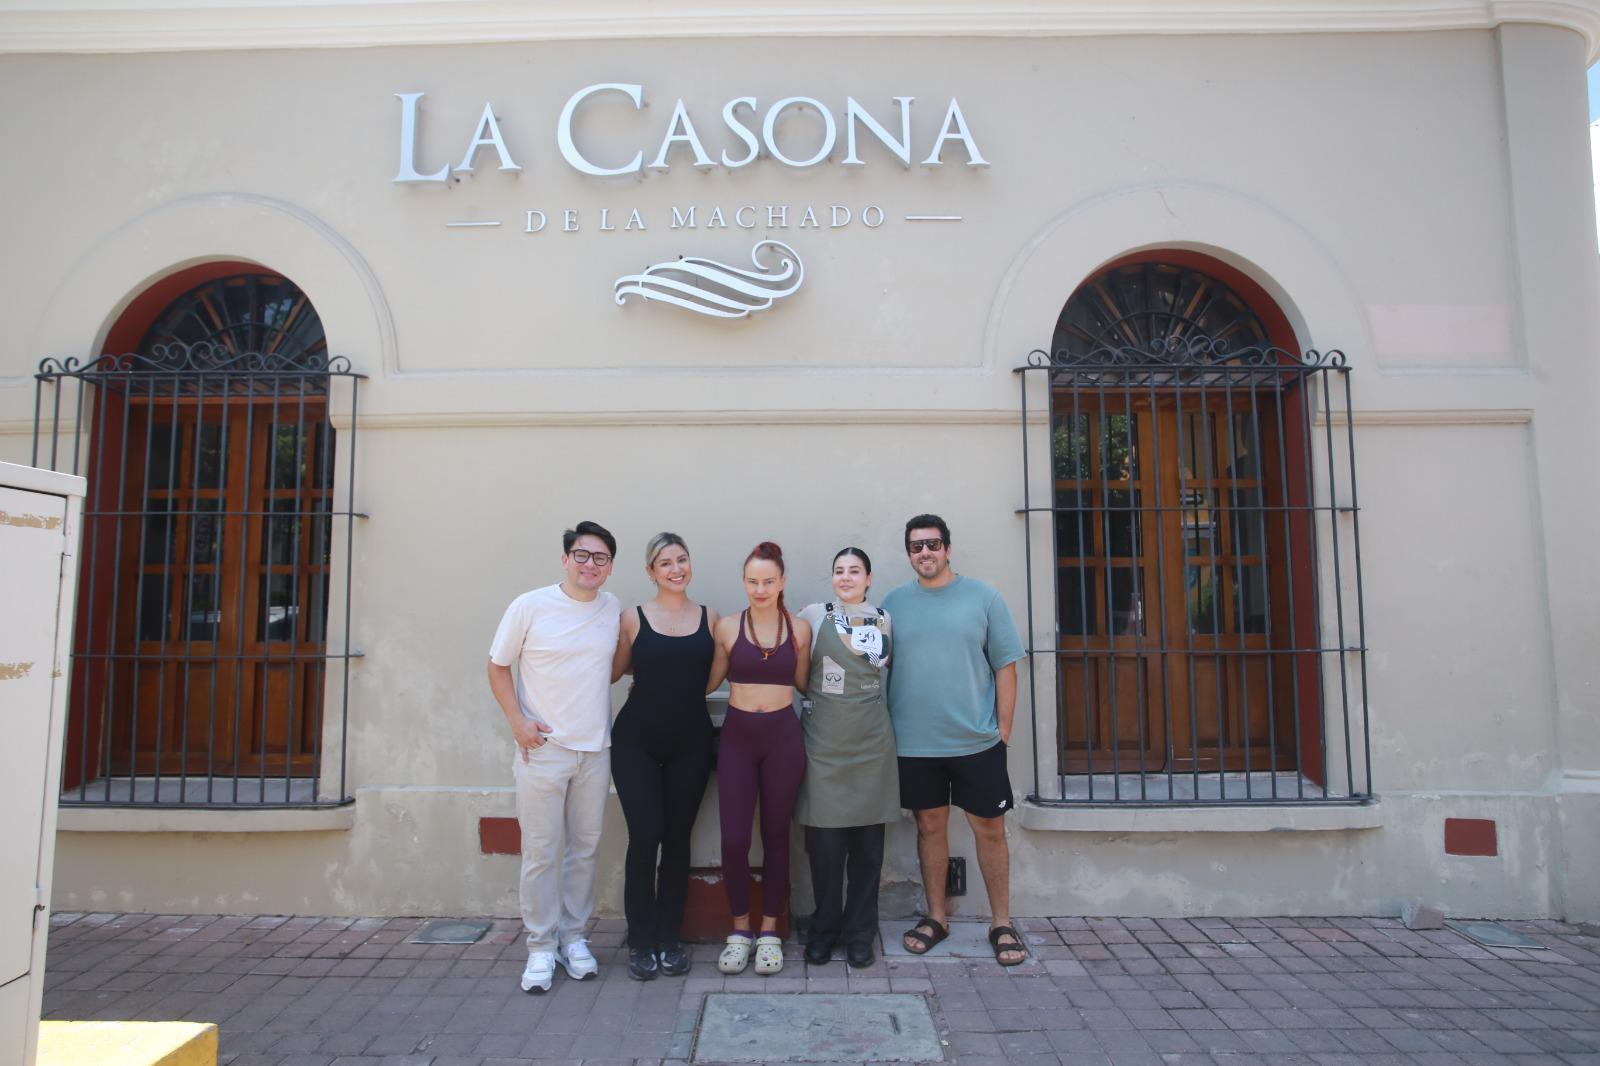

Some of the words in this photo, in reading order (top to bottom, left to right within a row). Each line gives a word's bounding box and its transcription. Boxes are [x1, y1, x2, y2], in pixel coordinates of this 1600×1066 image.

[393, 92, 522, 183] LA
[557, 83, 991, 176] CASONA
[525, 207, 580, 233] DE
[600, 205, 648, 231] LA
[670, 203, 886, 229] MACHADO
